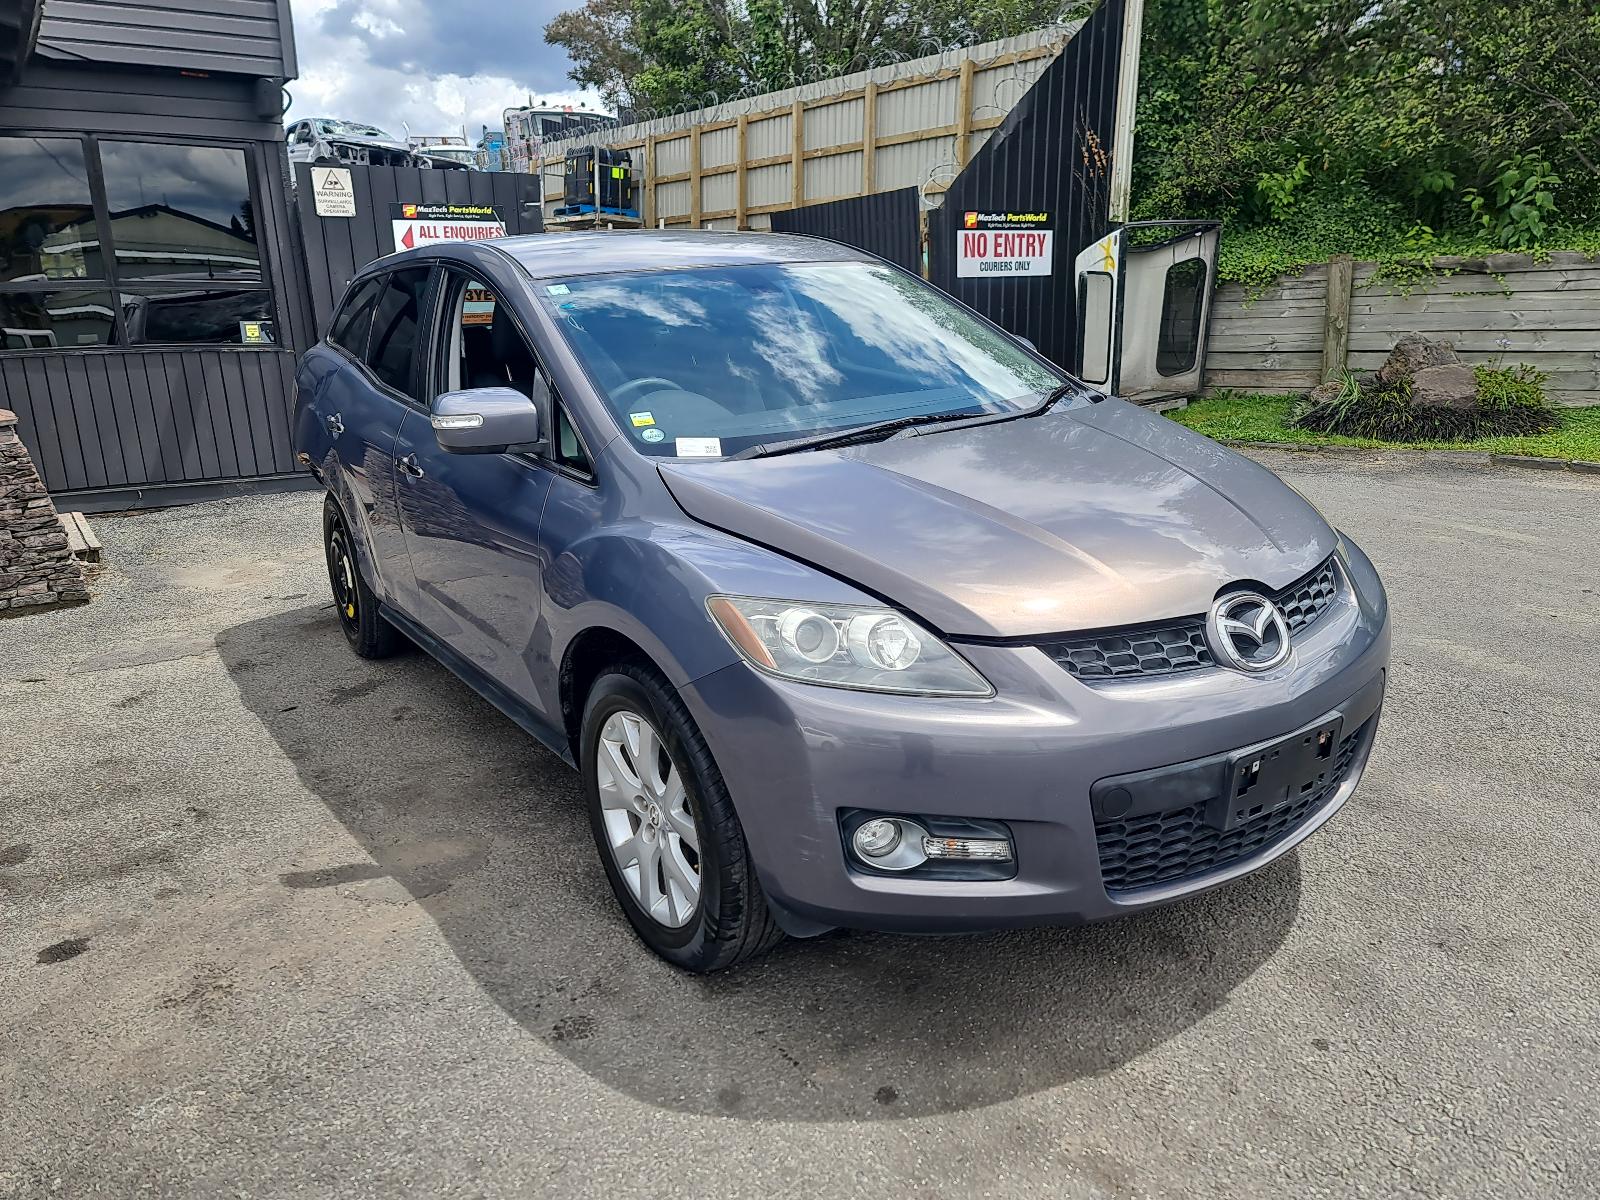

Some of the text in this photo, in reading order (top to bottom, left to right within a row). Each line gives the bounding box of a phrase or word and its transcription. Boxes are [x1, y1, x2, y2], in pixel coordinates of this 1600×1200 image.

[315, 190, 353, 198] WARNING
[448, 205, 493, 214] PartsWorld
[1007, 212, 1048, 222] PartsWorld
[419, 225, 503, 241] ALL ENQUIRIES
[963, 232, 1047, 258] NO ENTRY
[979, 260, 1031, 272] COURIERS ONLY
